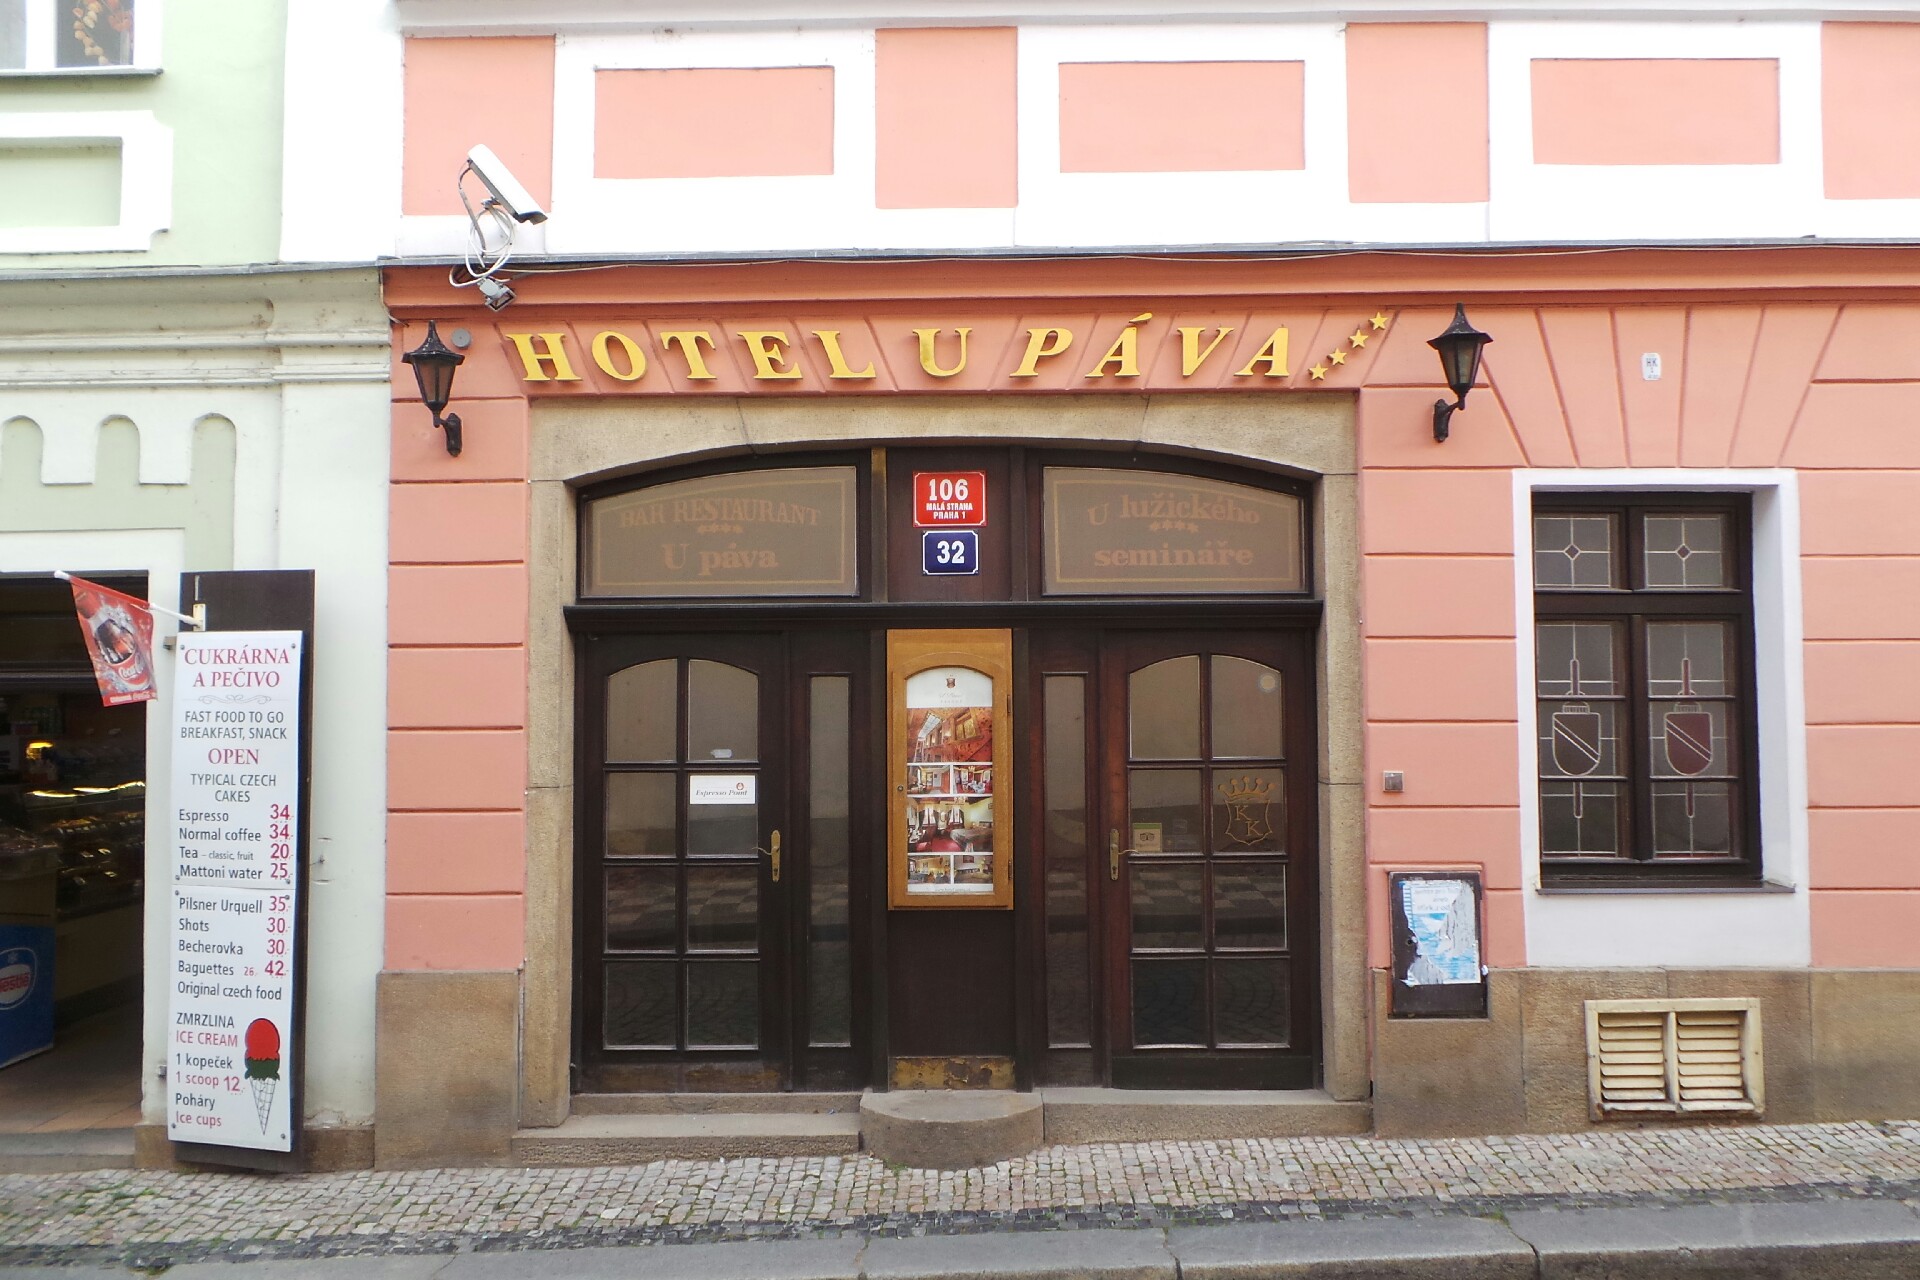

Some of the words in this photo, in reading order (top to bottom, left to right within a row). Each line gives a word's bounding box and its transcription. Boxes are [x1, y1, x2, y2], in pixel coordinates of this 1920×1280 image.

[505, 329, 878, 382] HOTEL
[913, 327, 973, 378] U
[1009, 312, 1291, 379] PÁVA
[929, 478, 969, 501] 106
[620, 502, 667, 528] BAR
[673, 497, 821, 527] RESTAURANT
[926, 502, 945, 510] MALÁ
[947, 502, 973, 510] STRANA
[1087, 503, 1109, 526] U
[1119, 492, 1260, 525] lužického
[933, 511, 959, 519] PRAHA
[662, 543, 691, 570] U
[698, 542, 780, 577] páva
[937, 540, 965, 564] 32
[1094, 541, 1255, 567] semináře
[184, 645, 290, 666] CUKRÁRNA
[193, 672, 205, 688] A
[211, 668, 280, 688] PEČIVO
[185, 711, 211, 723] FAST
[215, 711, 245, 723] FOOD
[249, 711, 263, 723] TO
[267, 711, 284, 723] GO
[180, 727, 246, 741] BREAKFAST,
[249, 727, 287, 740] SNACK
[208, 748, 259, 765] OPEN
[191, 774, 236, 786] TYPICAL
[240, 774, 277, 787] CZECH
[215, 790, 250, 802] CAKES
[179, 809, 229, 826] Espresso
[1234, 805, 1252, 821] K
[179, 827, 221, 841] Normal
[225, 828, 262, 842] coffee
[1245, 820, 1264, 836] K
[179, 847, 198, 859] Tea
[237, 851, 254, 861] fruit
[180, 864, 225, 878] Mattoni
[228, 867, 263, 880] water
[179, 897, 217, 911] Pilsner
[221, 900, 263, 916] Urquell
[179, 918, 210, 932] Shots
[178, 939, 243, 955] Becherovka
[178, 960, 234, 976] Baguettes
[178, 981, 220, 998] Original
[222, 984, 252, 999] czech
[256, 986, 282, 1000] food
[176, 1012, 235, 1028] ZMRZLINA
[176, 1031, 194, 1044] ICE
[197, 1033, 238, 1047] CREAM
[176, 1053, 182, 1066] 1
[185, 1053, 233, 1070] kopeček
[176, 1071, 182, 1083] 1
[185, 1074, 219, 1087] scoop
[175, 1093, 215, 1110] Poháry
[175, 1114, 193, 1126] Ice
[196, 1116, 222, 1128] cups
